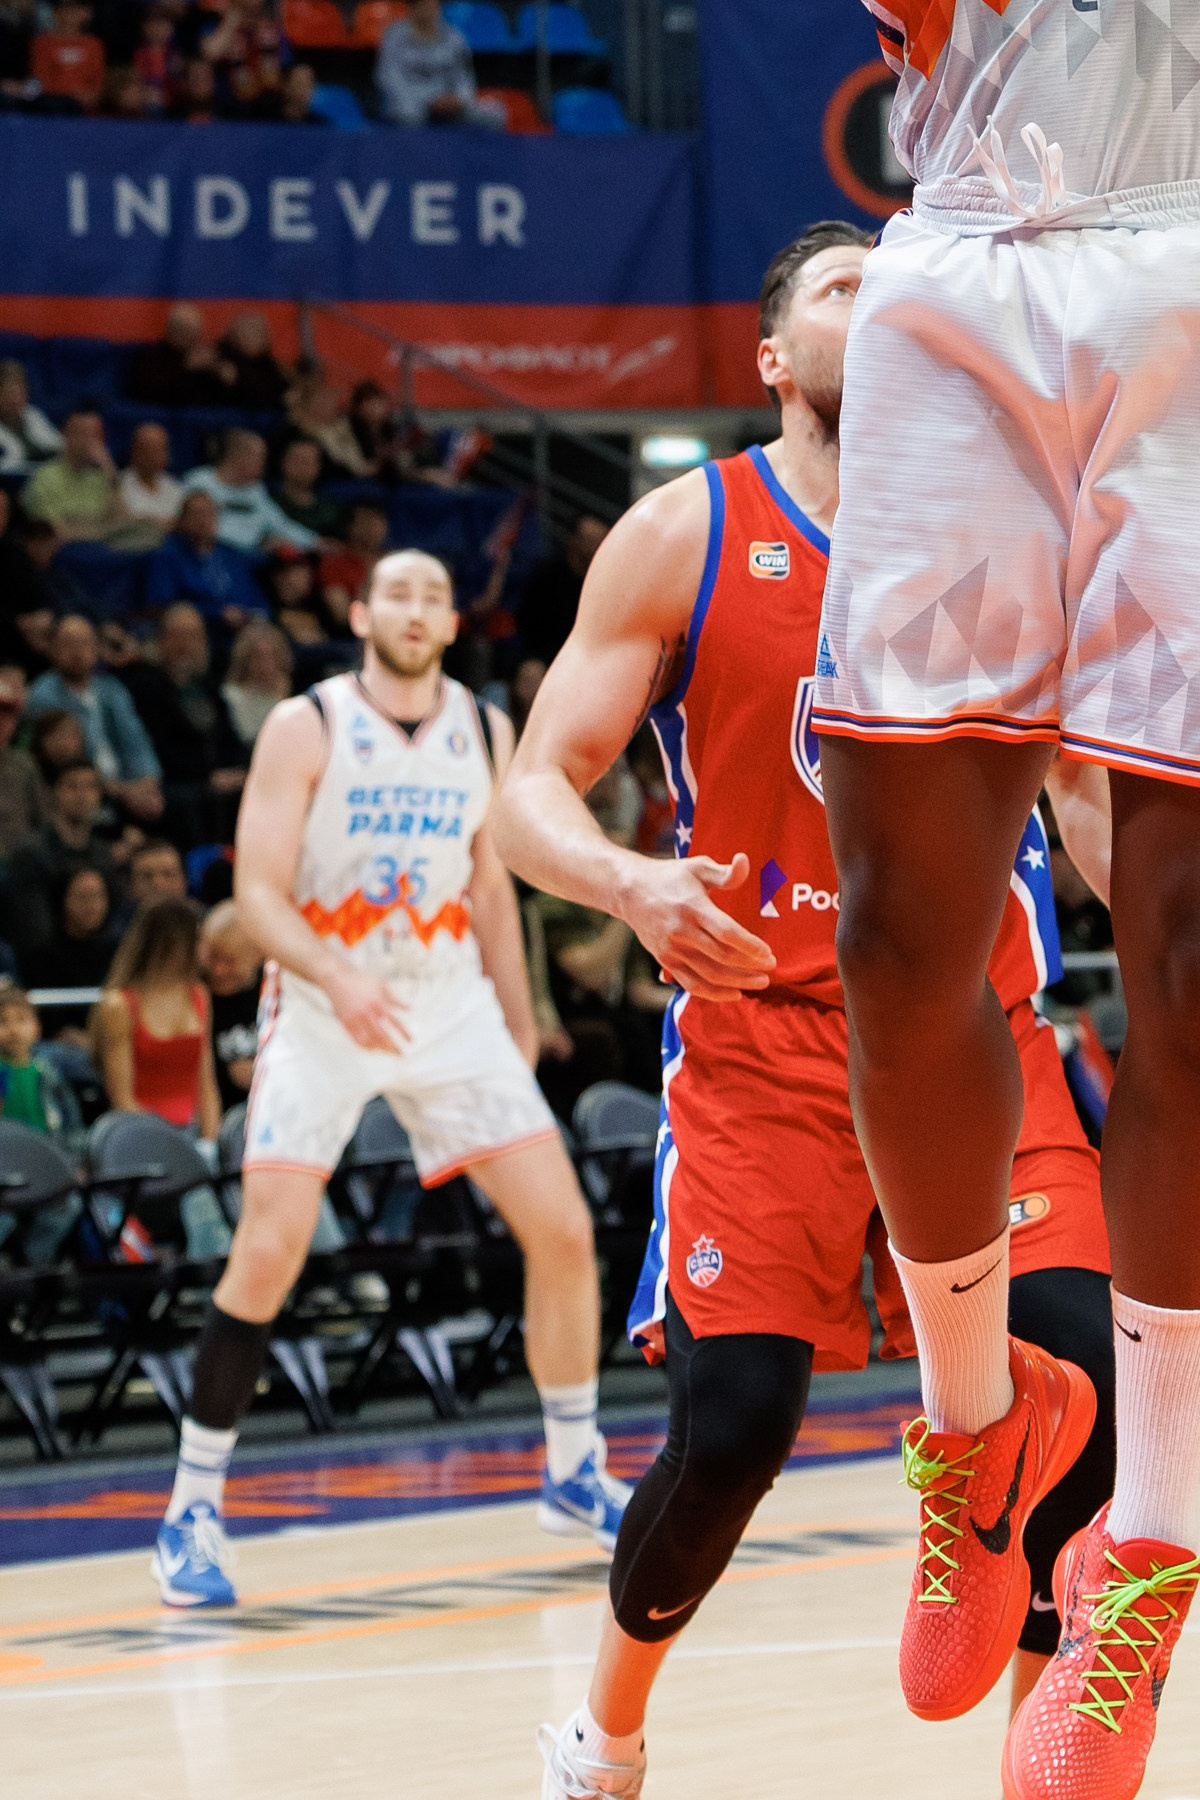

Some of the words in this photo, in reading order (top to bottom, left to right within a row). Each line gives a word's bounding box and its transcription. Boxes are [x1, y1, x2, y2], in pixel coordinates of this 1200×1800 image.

[67, 172, 527, 248] INDEVER
[346, 784, 470, 809] BETCITY
[347, 811, 463, 839] PARMA
